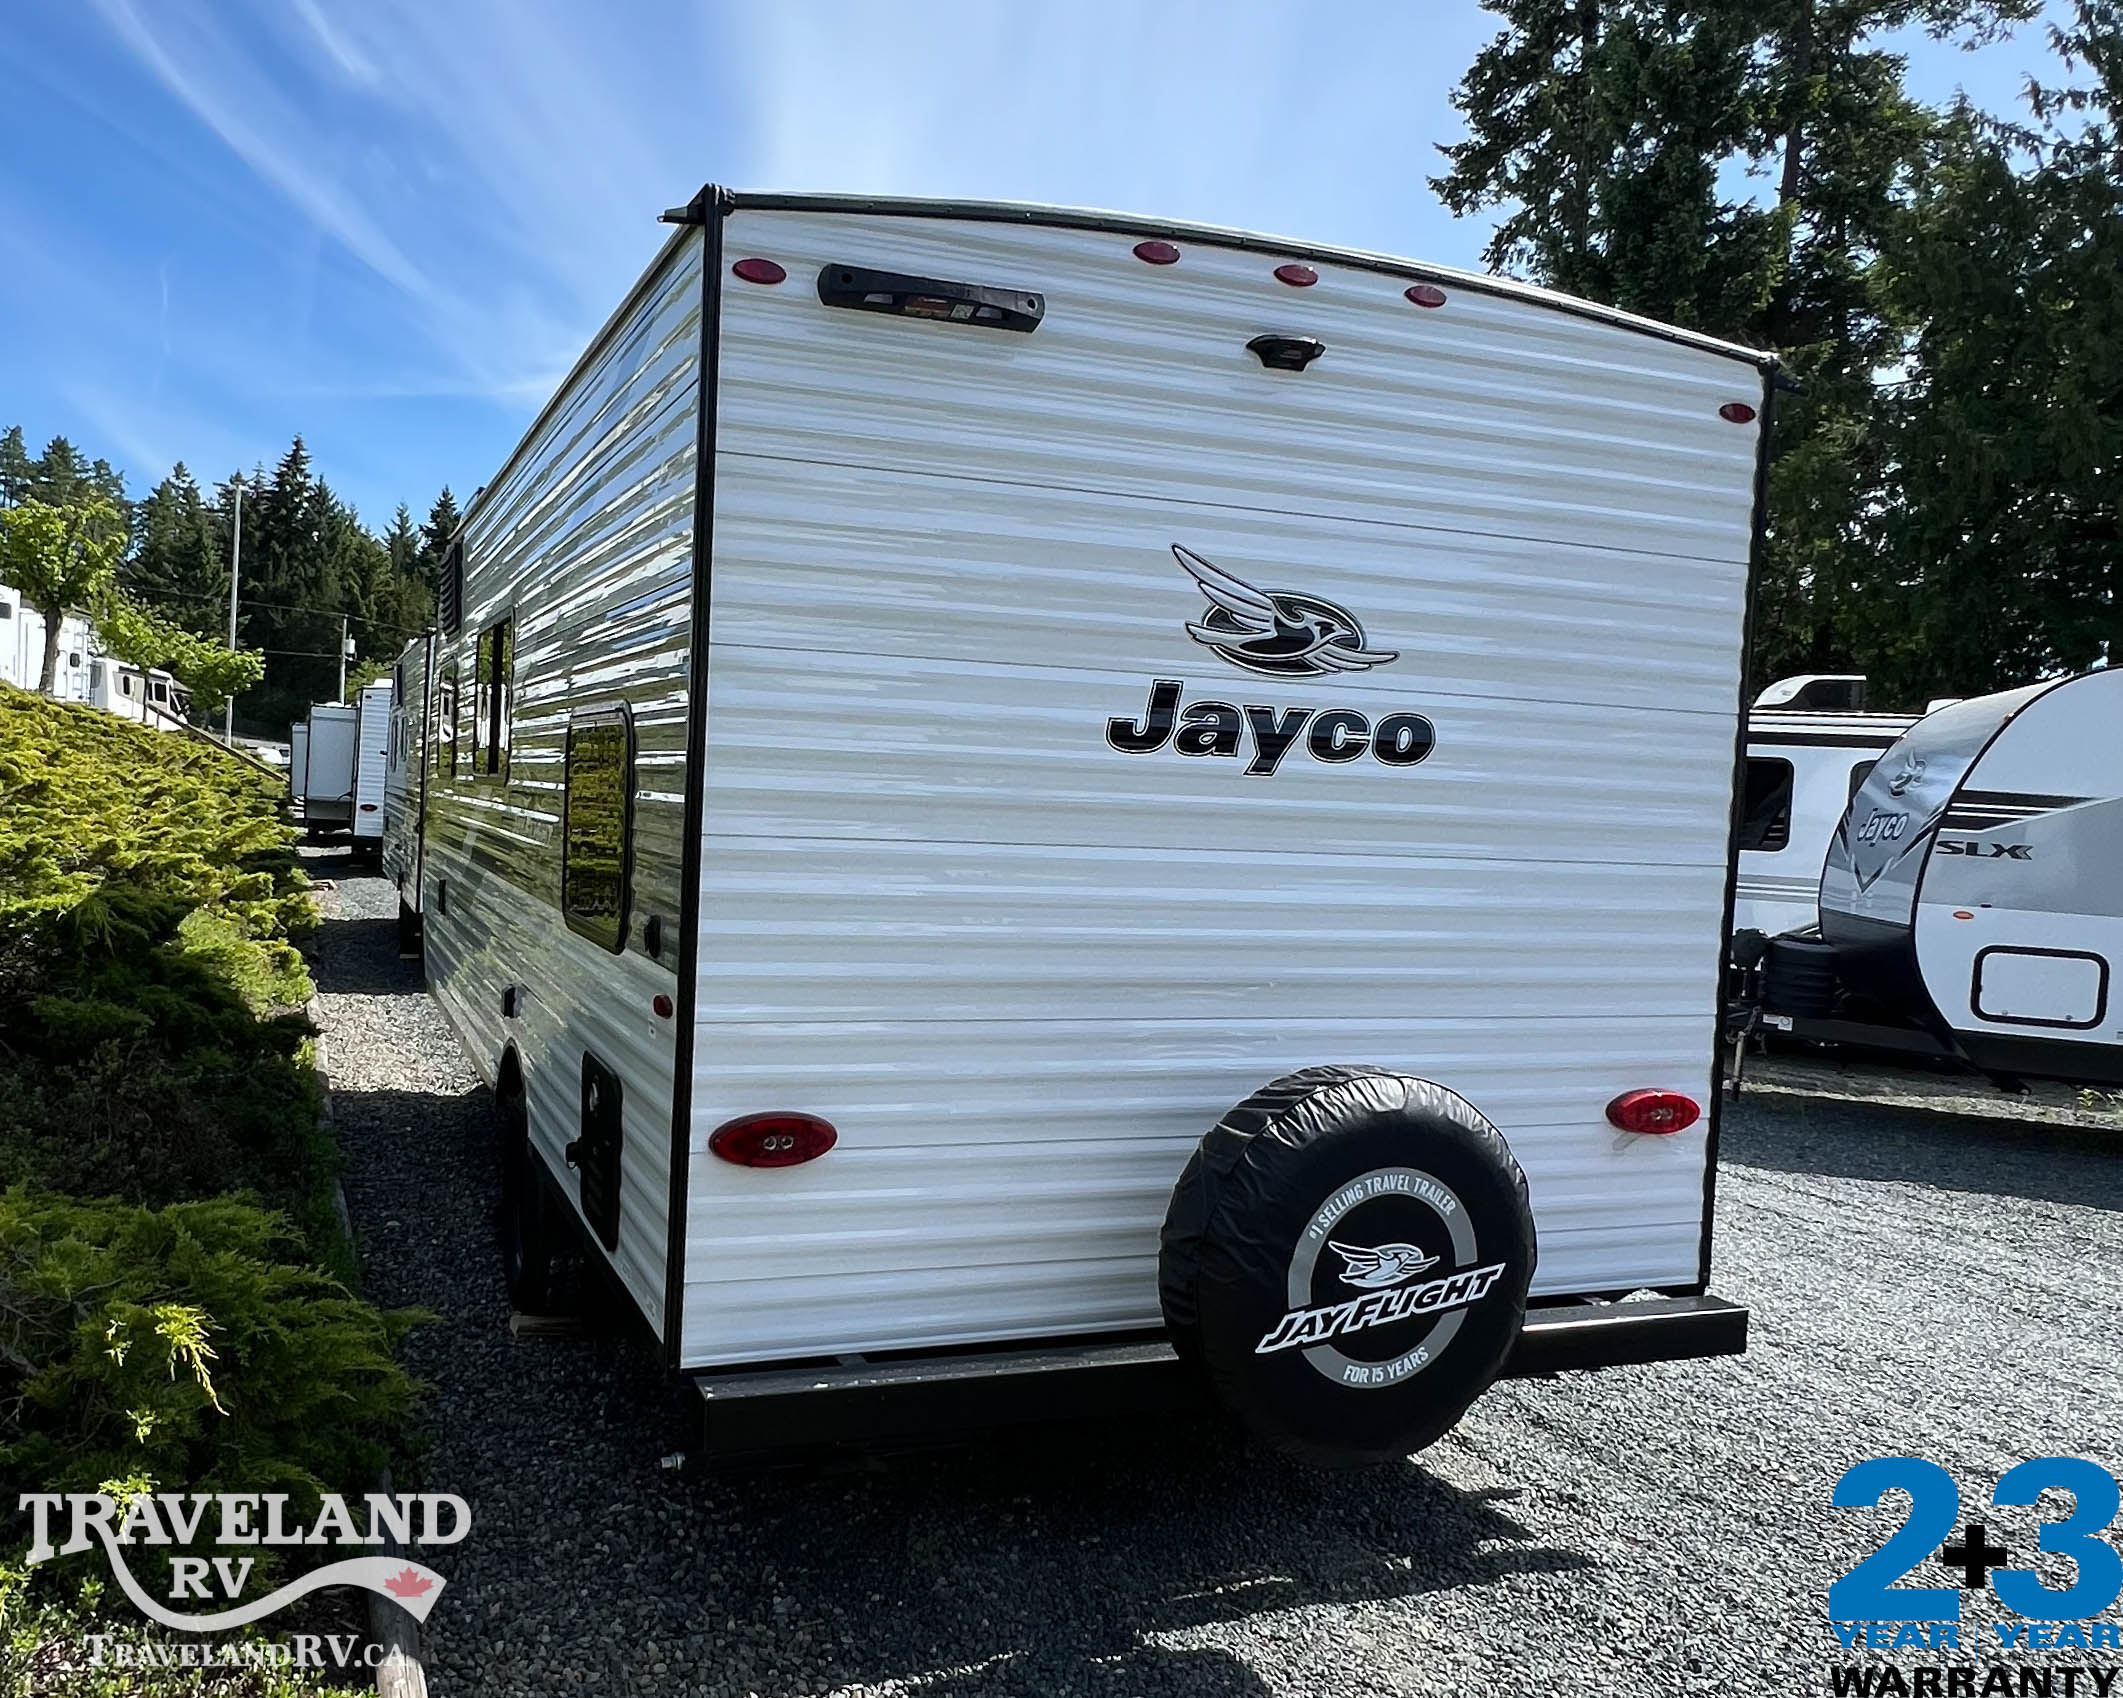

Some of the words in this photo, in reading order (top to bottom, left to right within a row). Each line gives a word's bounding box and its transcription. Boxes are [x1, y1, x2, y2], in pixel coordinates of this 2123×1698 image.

[1104, 678, 1437, 777] Jayco
[1857, 807, 1910, 847] Jayco
[1936, 840, 2034, 861] SLX
[1308, 1224, 1324, 1239] #1
[1318, 1183, 1364, 1228] SELLING
[1365, 1174, 1411, 1195] TRAVEL
[1413, 1176, 1457, 1216] TRAILER
[1343, 1364, 1370, 1383] FOR
[1371, 1366, 1385, 1383] 15
[1386, 1346, 1429, 1379] YEARS
